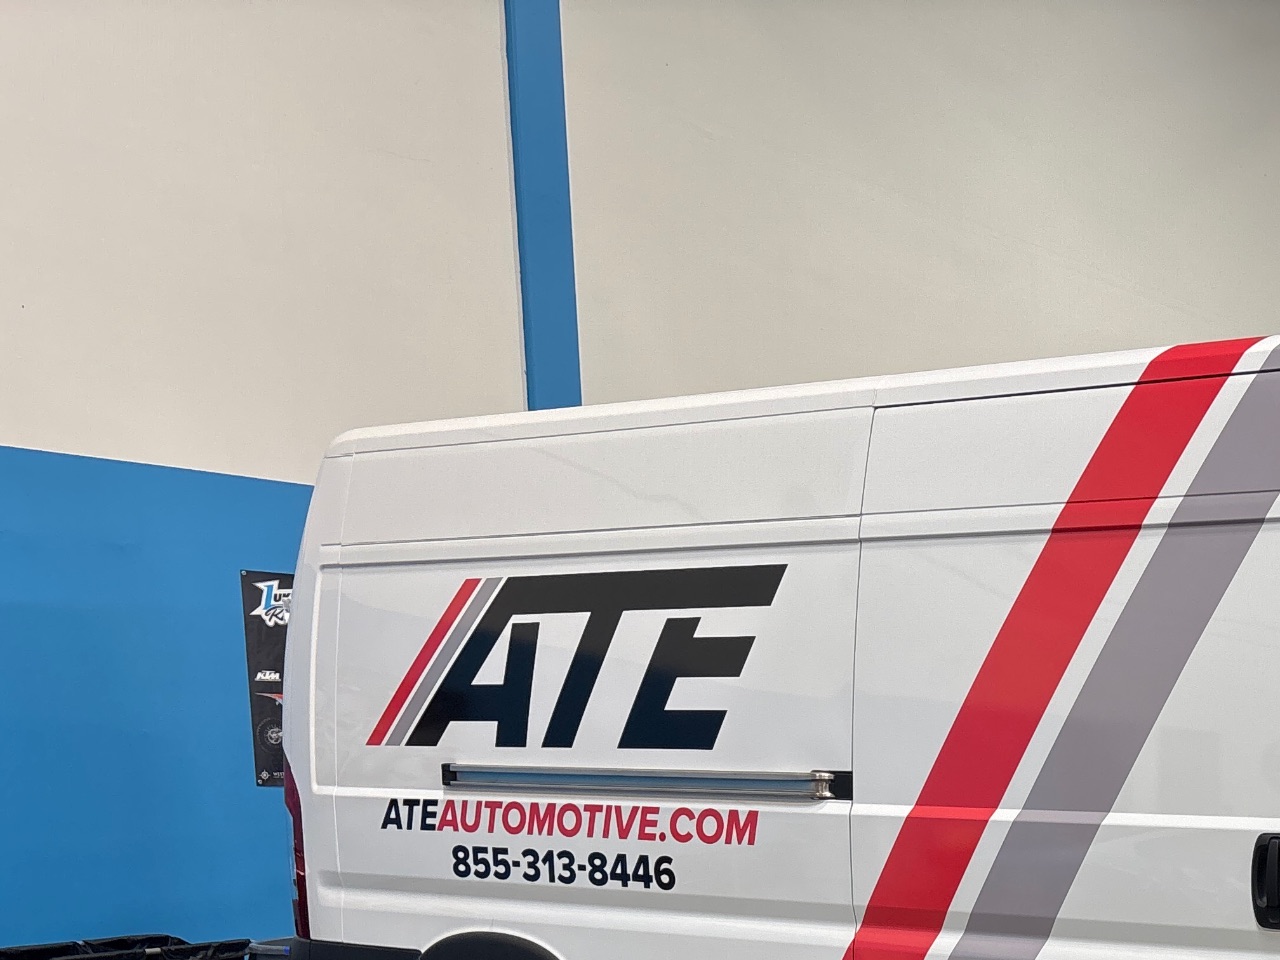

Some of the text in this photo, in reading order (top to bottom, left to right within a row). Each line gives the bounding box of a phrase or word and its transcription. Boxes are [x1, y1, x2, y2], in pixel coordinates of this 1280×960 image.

[255, 670, 281, 681] KTM
[405, 564, 788, 750] ATE
[381, 798, 759, 846] ATEAUTOMOTIVE.COM
[451, 845, 676, 890] 855-313-8446
